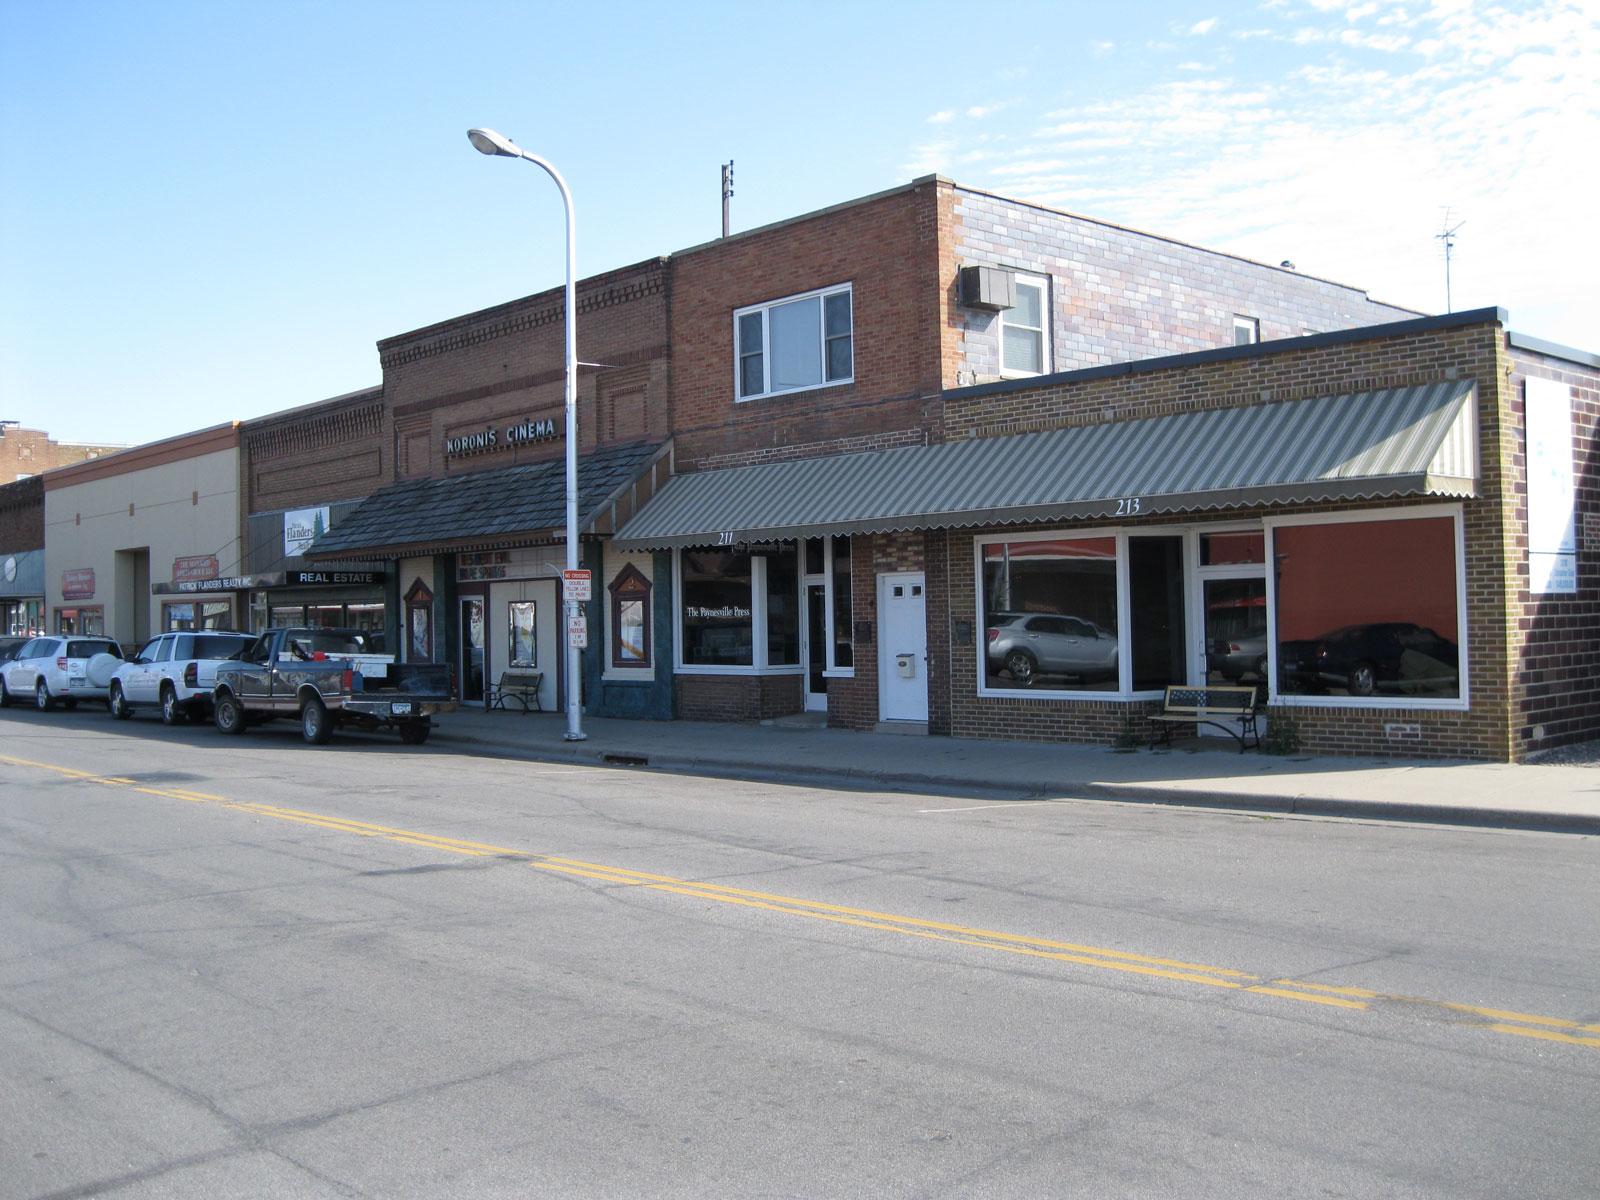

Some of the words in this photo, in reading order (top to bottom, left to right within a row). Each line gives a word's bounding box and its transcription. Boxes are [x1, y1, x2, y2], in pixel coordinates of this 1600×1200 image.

[447, 430, 496, 453] KORONIS
[506, 418, 555, 443] CINEMA
[1116, 498, 1140, 515] 213
[287, 526, 313, 540] Flanders
[300, 572, 329, 582] REAL
[333, 573, 373, 582] ESTATE
[198, 579, 222, 590] FLANDERS
[687, 607, 698, 617] The
[734, 606, 750, 616] Press
